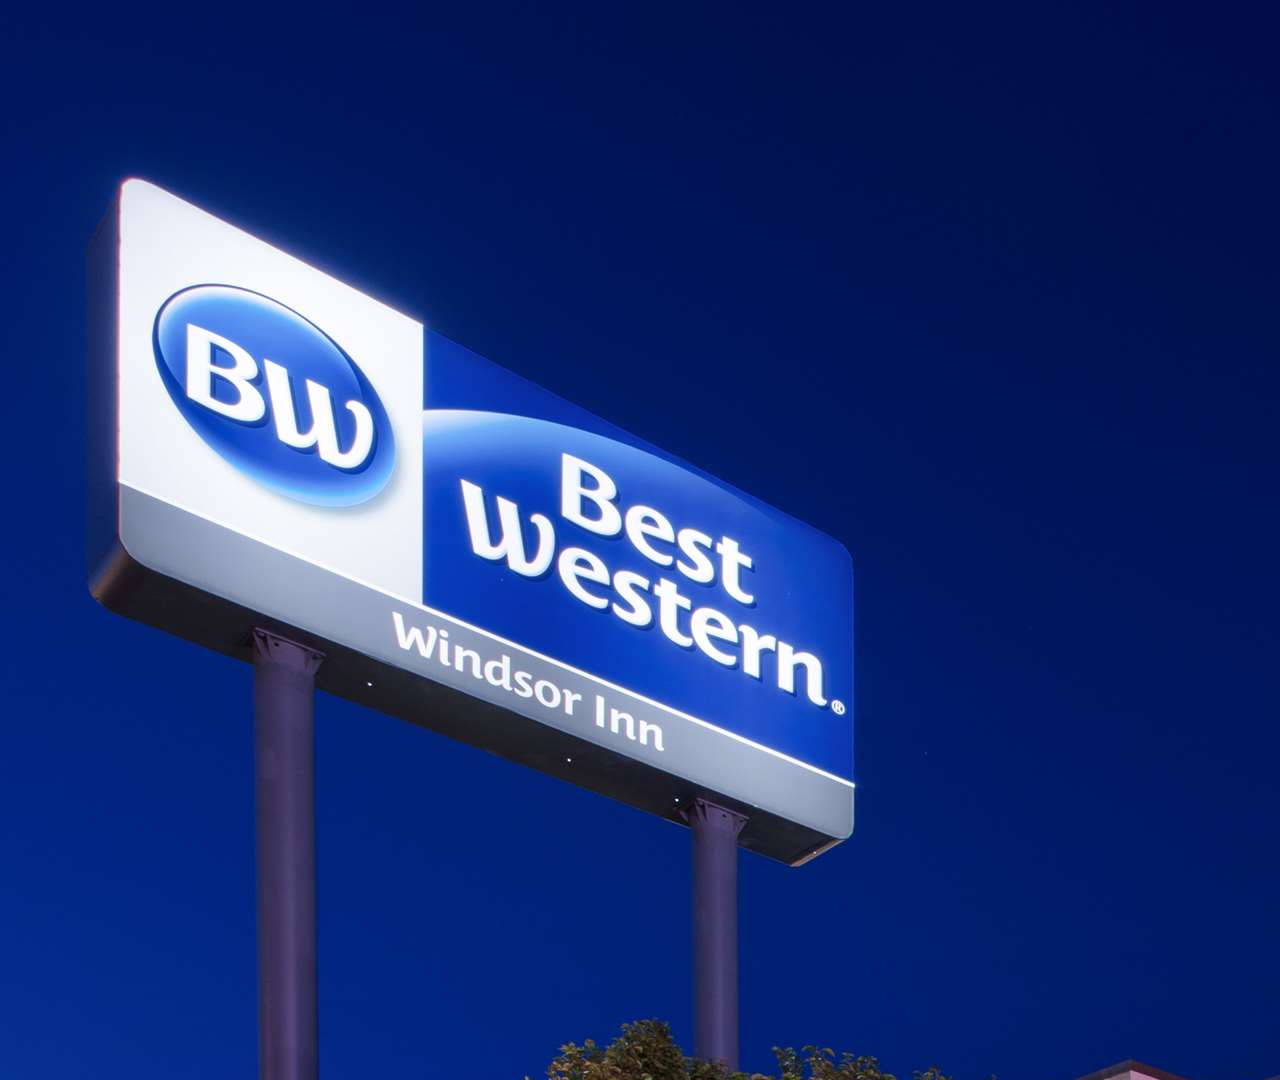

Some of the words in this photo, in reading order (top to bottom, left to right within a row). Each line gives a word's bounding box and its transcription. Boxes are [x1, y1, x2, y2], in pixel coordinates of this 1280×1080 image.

[186, 323, 374, 470] BW
[460, 478, 828, 707] Western
[561, 452, 755, 604] Best
[391, 611, 582, 715] Windsor
[595, 694, 665, 752] Inn
